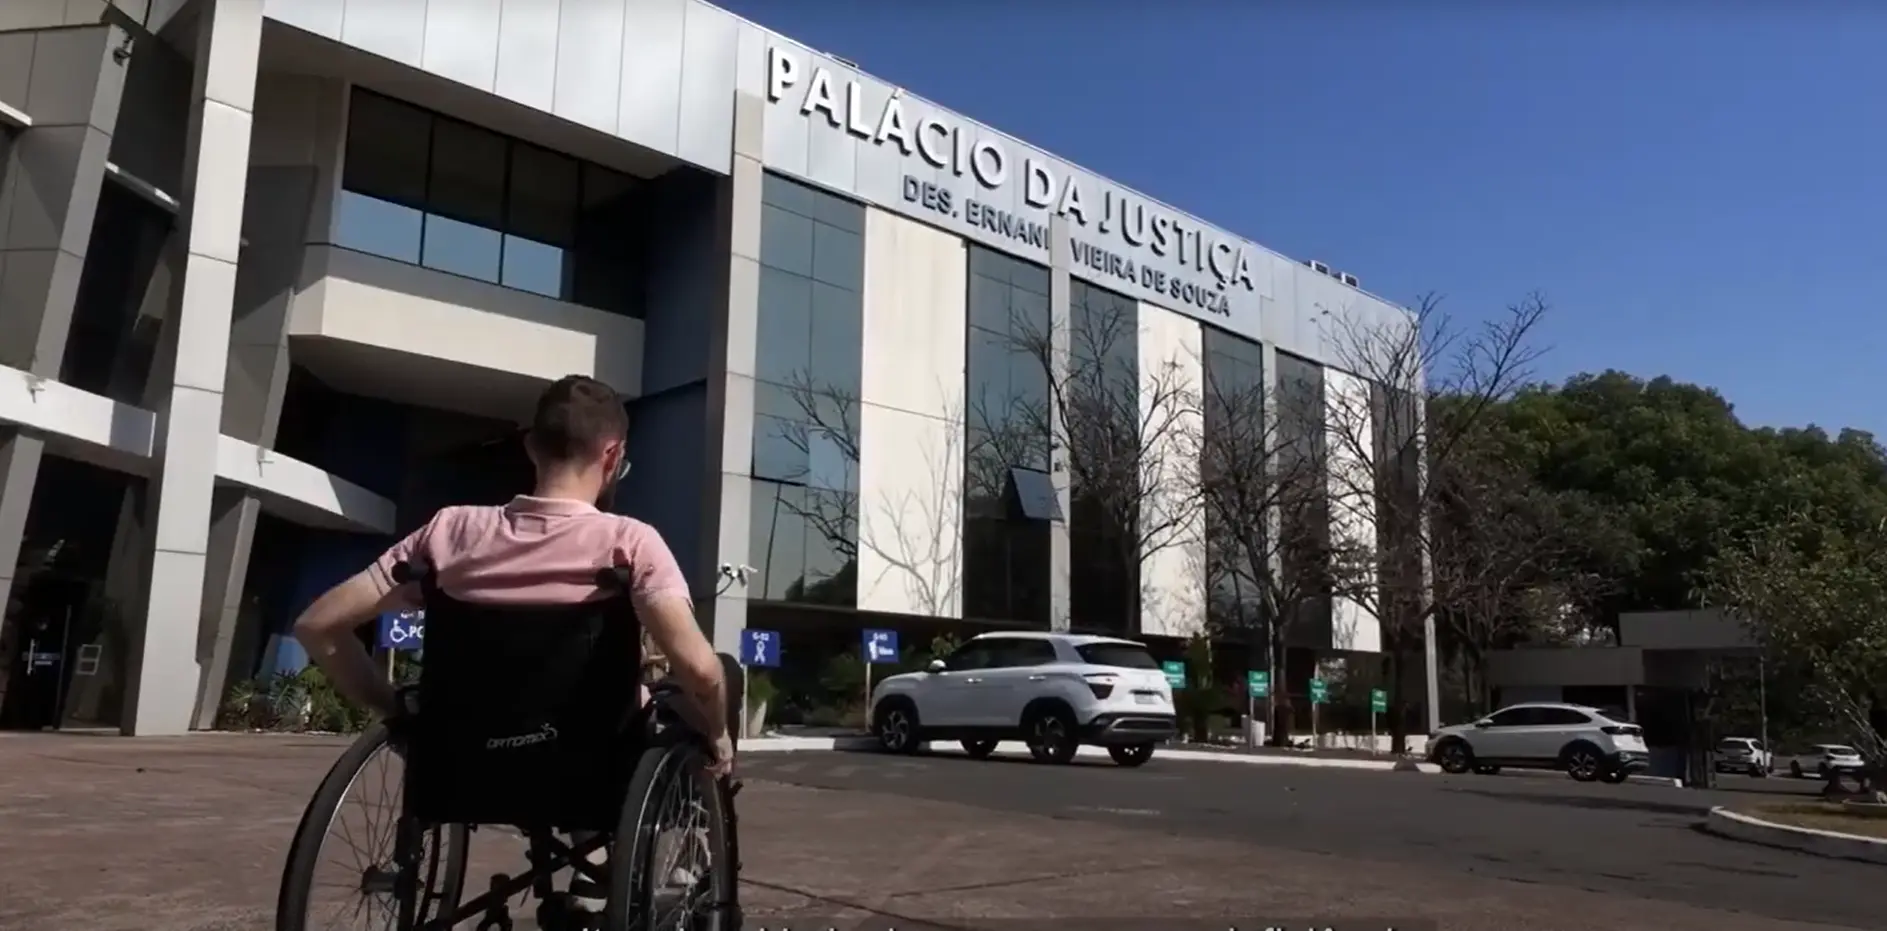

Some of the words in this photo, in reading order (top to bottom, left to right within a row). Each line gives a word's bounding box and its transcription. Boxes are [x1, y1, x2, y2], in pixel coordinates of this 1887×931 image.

[768, 47, 1006, 189] PALÁCIO
[1025, 158, 1088, 227] DA
[1097, 190, 1254, 291] JUSTIÇA
[903, 174, 959, 218] DES.
[966, 198, 1051, 251] ERNANI
[1070, 238, 1137, 285] VIEIRA
[1141, 264, 1168, 294] DE
[1169, 276, 1232, 318] SOUZA
